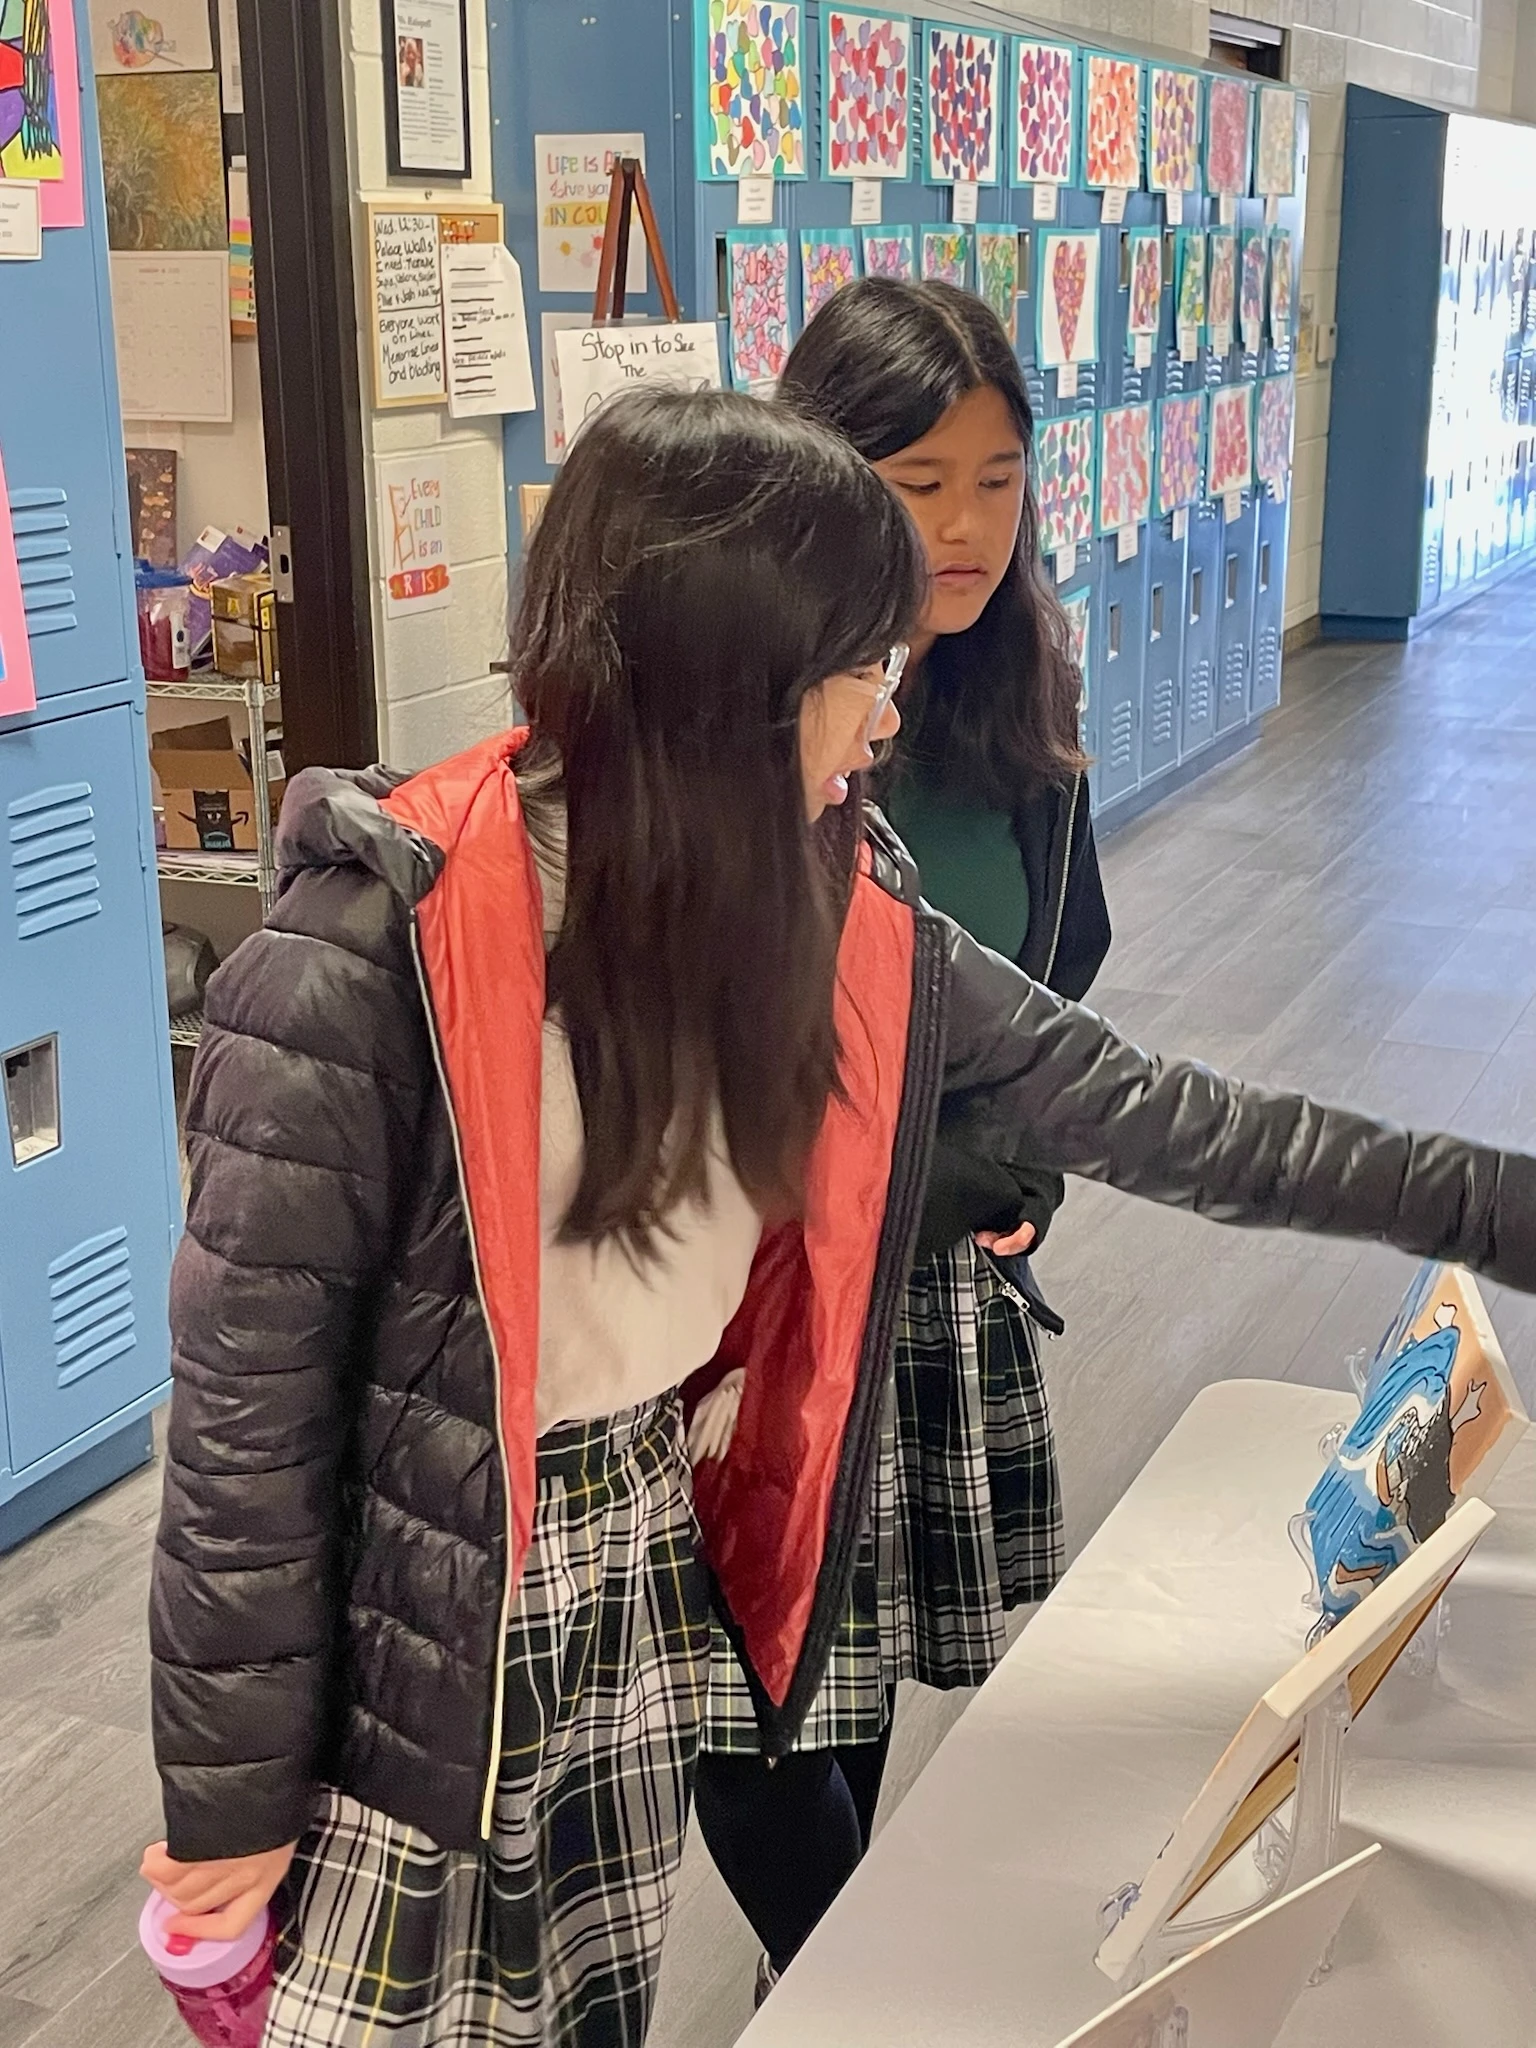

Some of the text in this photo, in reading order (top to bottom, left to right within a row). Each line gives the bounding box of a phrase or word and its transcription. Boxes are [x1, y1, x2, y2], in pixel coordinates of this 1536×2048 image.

[573, 205, 604, 225] COL
[581, 332, 624, 364] Stop
[629, 334, 648, 355] in
[652, 334, 671, 354] to
[620, 364, 647, 377] The
